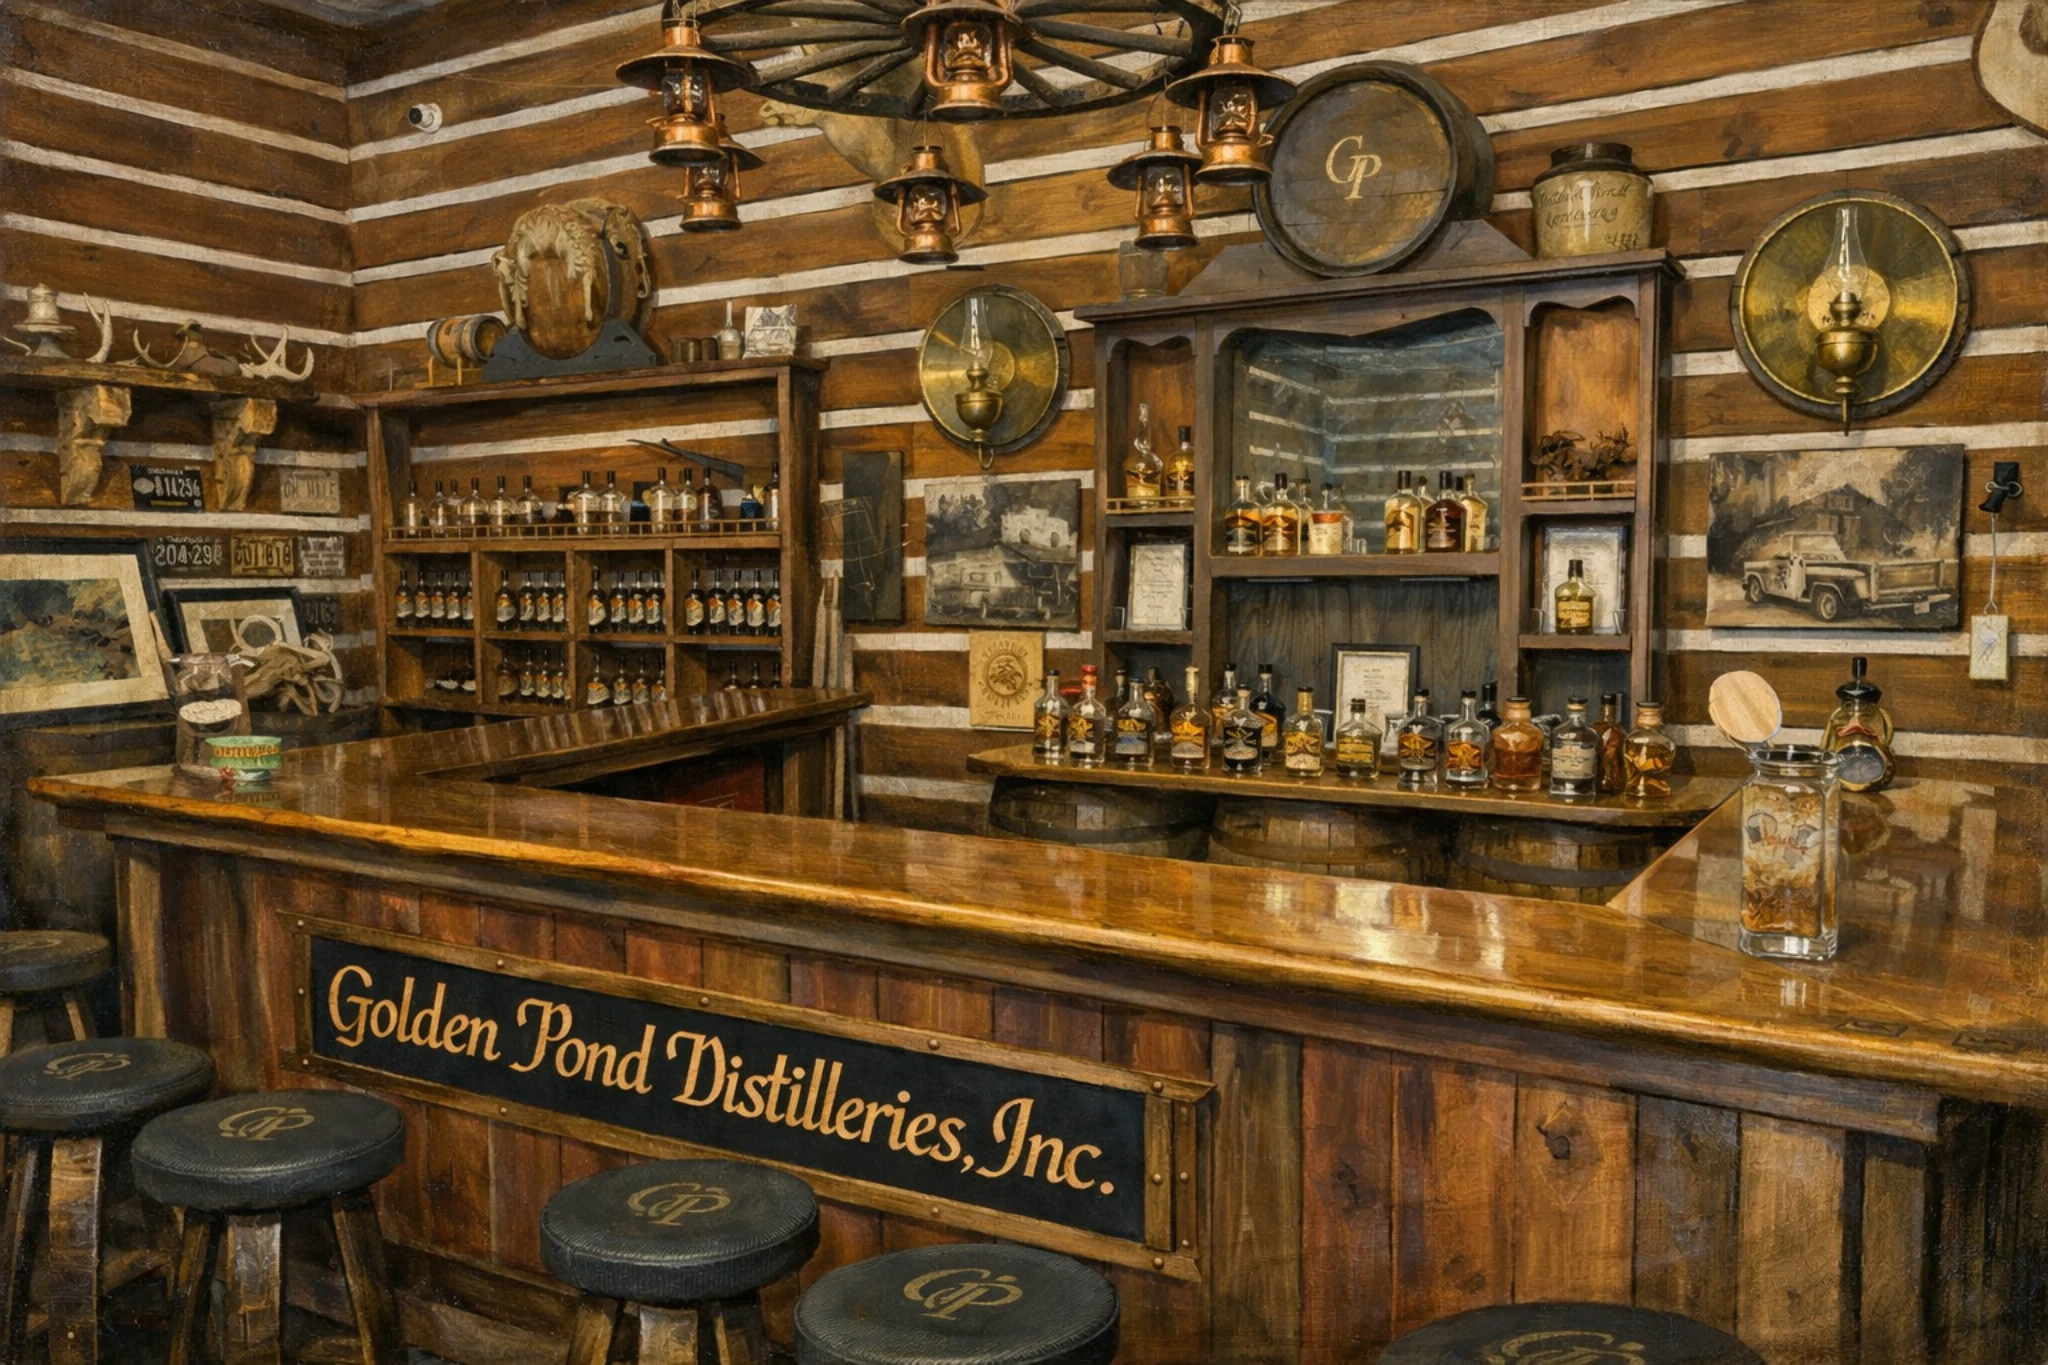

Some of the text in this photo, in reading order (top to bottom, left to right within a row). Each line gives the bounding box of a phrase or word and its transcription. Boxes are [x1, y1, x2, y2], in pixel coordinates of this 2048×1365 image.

[1325, 135, 1382, 200] GP
[328, 965, 1115, 1195] Golden Pond Distilleries, Inc.
[627, 1183, 731, 1226] GP
[903, 1268, 1023, 1321] GP
